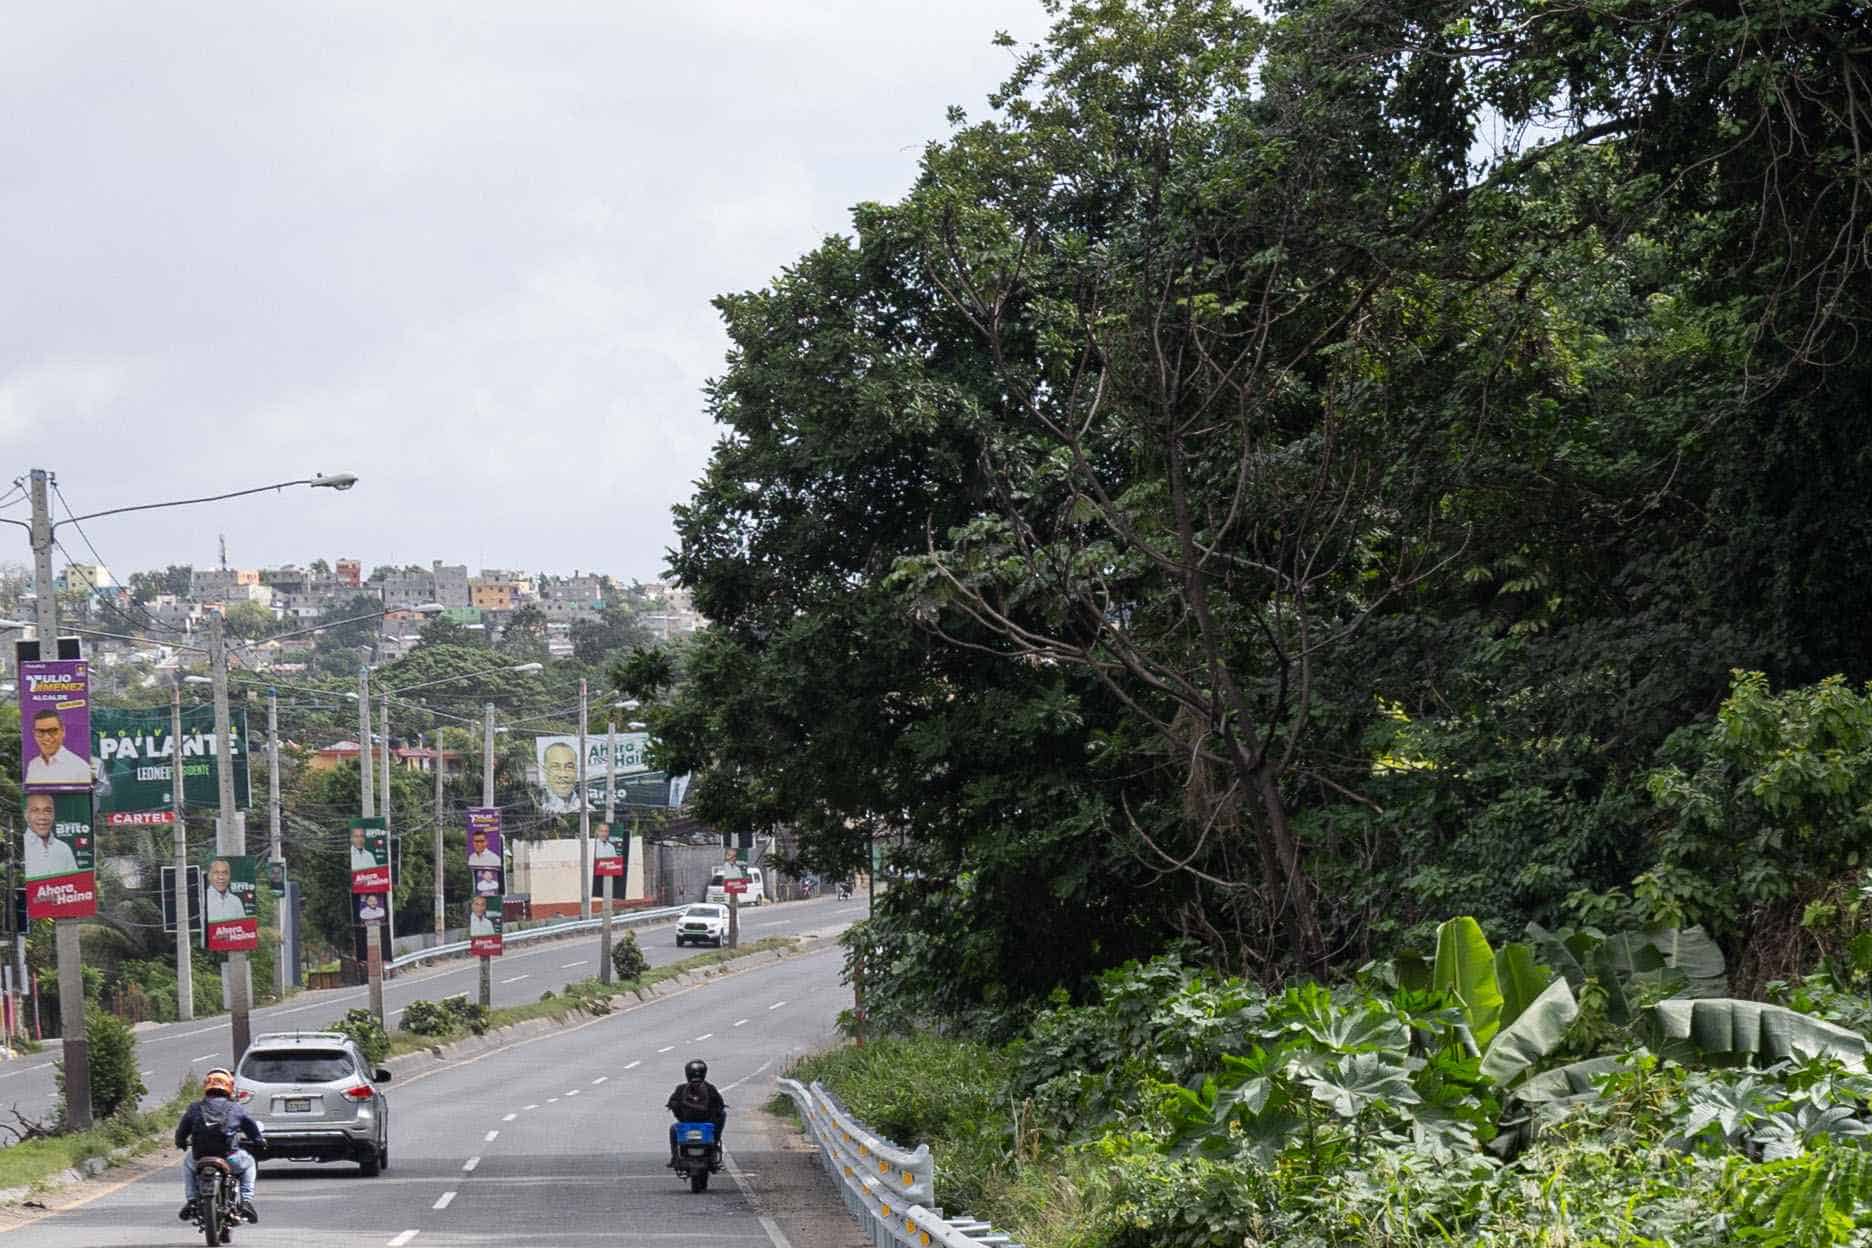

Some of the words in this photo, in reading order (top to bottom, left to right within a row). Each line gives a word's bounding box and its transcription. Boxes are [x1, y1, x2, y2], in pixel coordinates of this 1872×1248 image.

[26, 674, 72, 691] TULIO
[100, 734, 239, 759] PA'LANTE
[137, 767, 171, 781] LEONEL
[113, 813, 171, 825] CARTEL
[55, 822, 90, 834] Brito
[37, 883, 74, 897] Ahora
[57, 891, 93, 905] Haina
